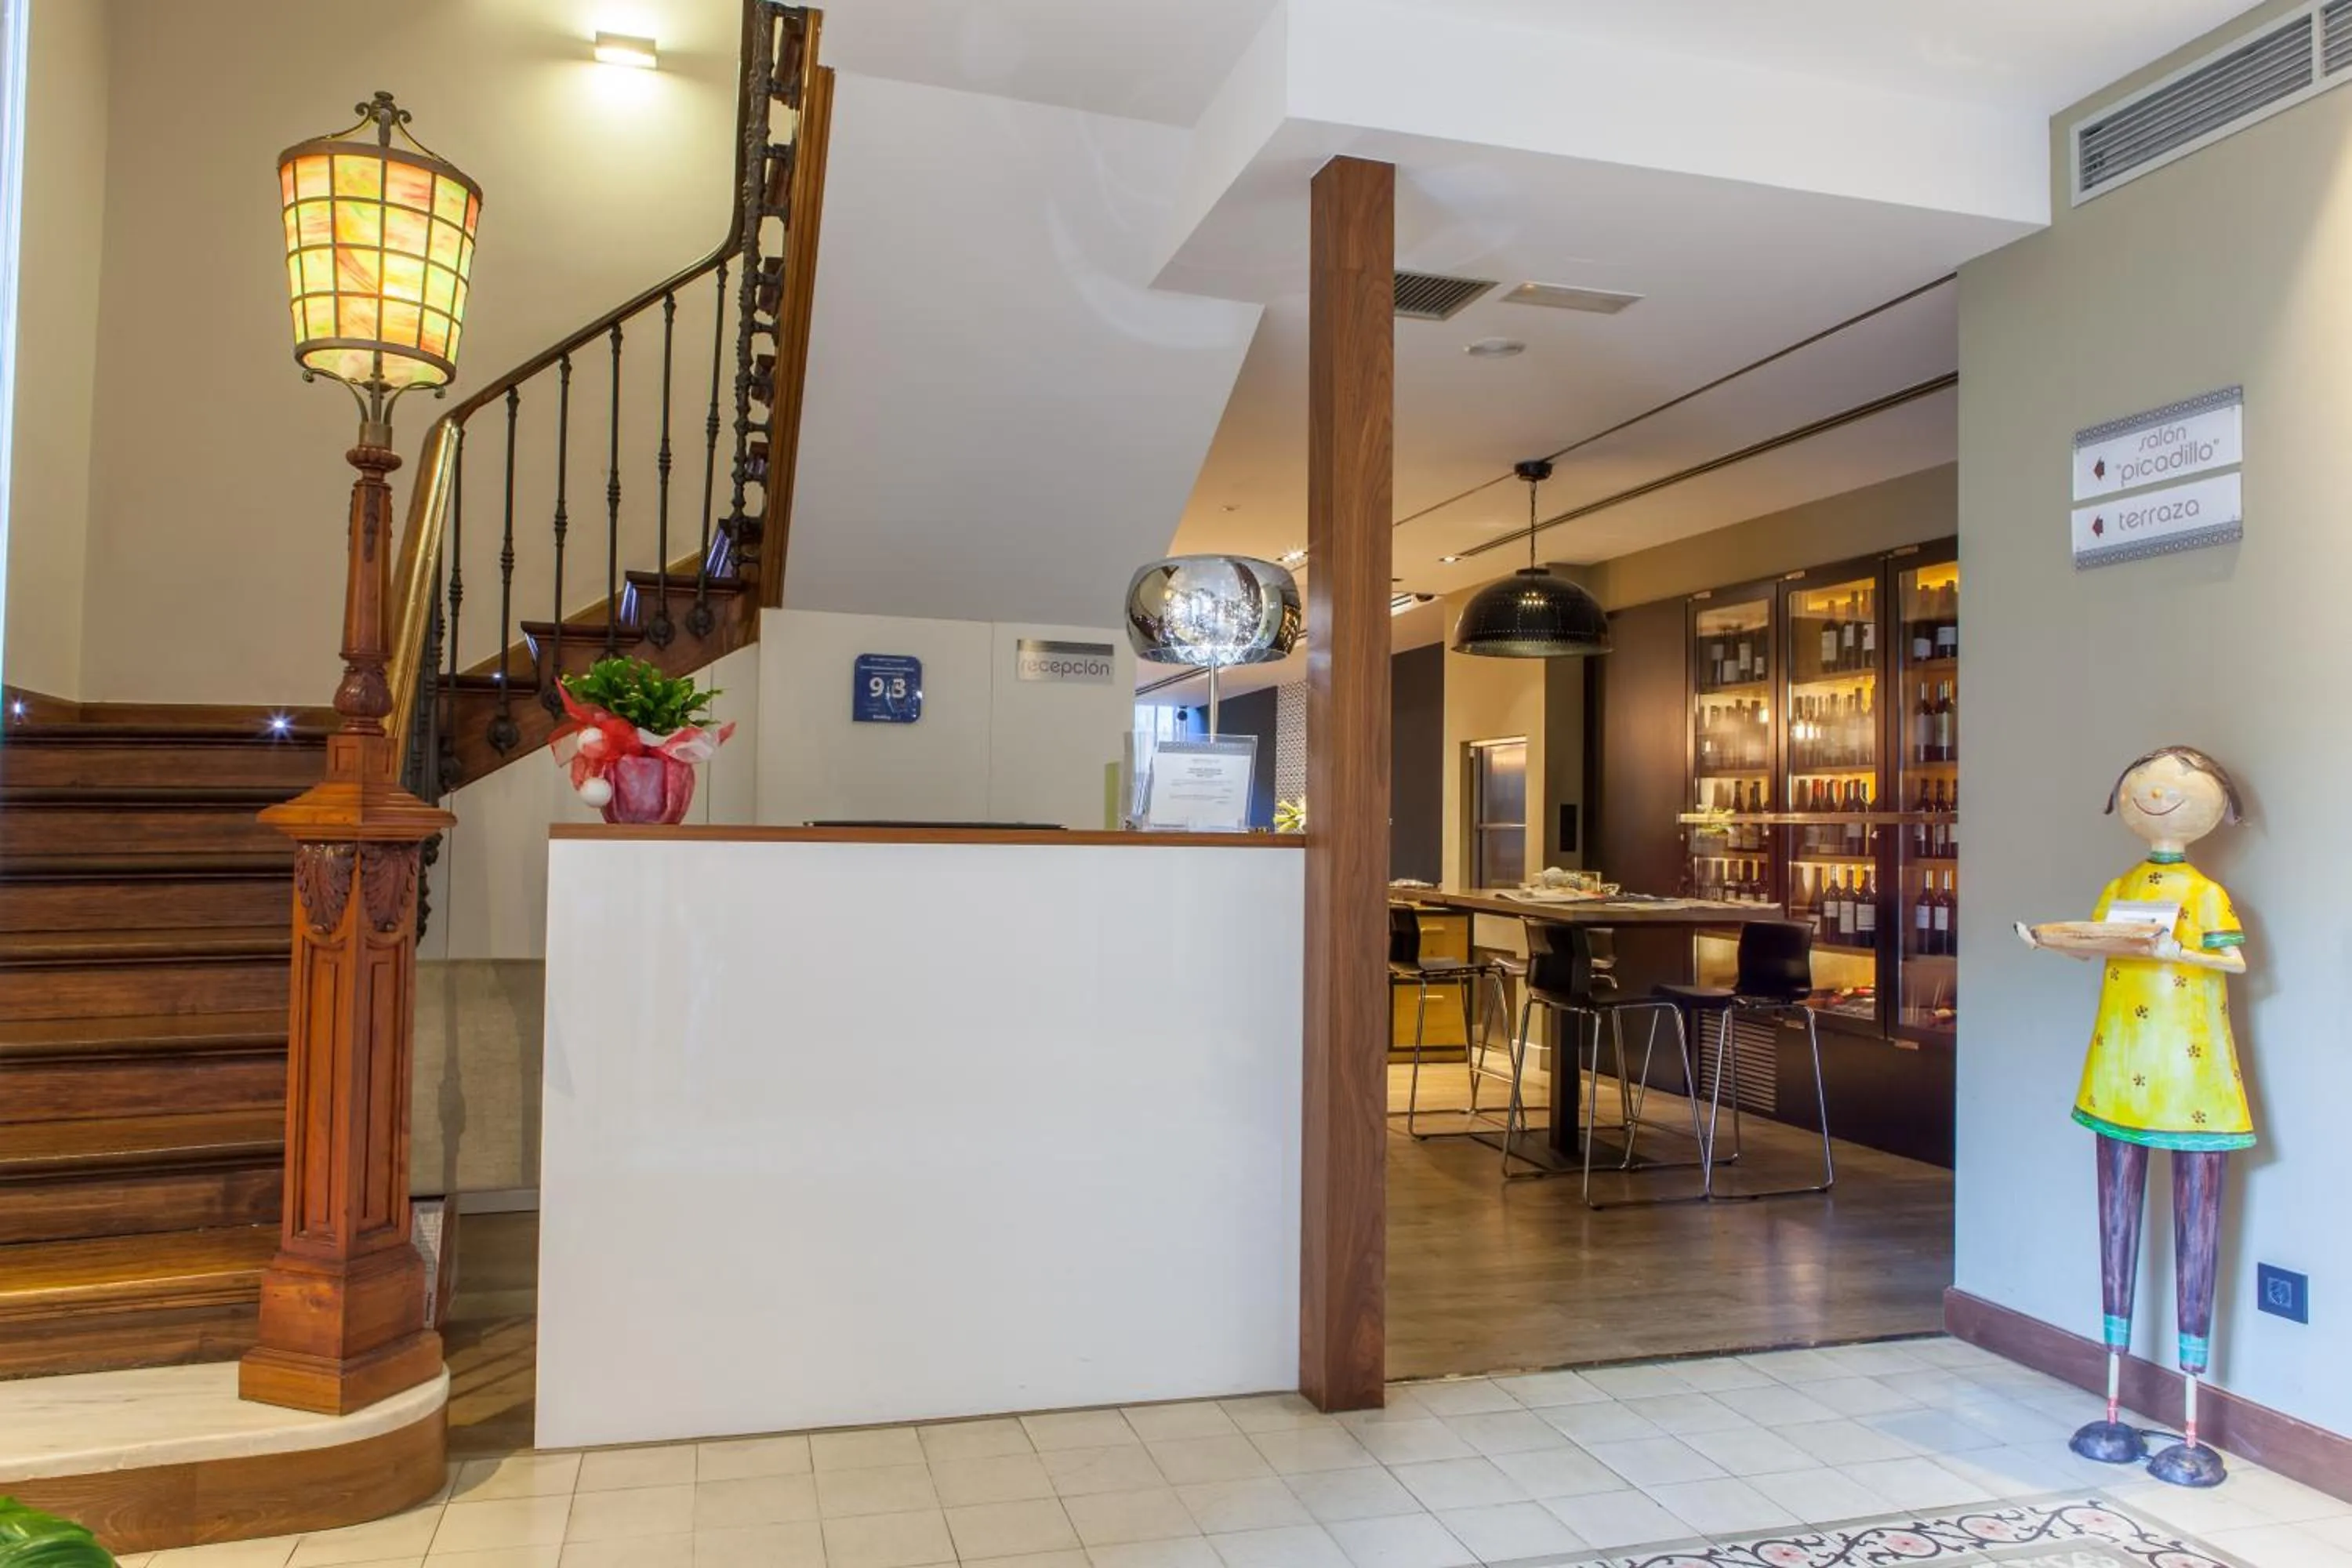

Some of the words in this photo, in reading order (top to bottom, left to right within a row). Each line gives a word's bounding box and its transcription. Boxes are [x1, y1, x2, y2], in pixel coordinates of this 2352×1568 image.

[2138, 426, 2187, 452] salón
[2118, 499, 2200, 531] terraza
[1021, 659, 1109, 677] recepción
